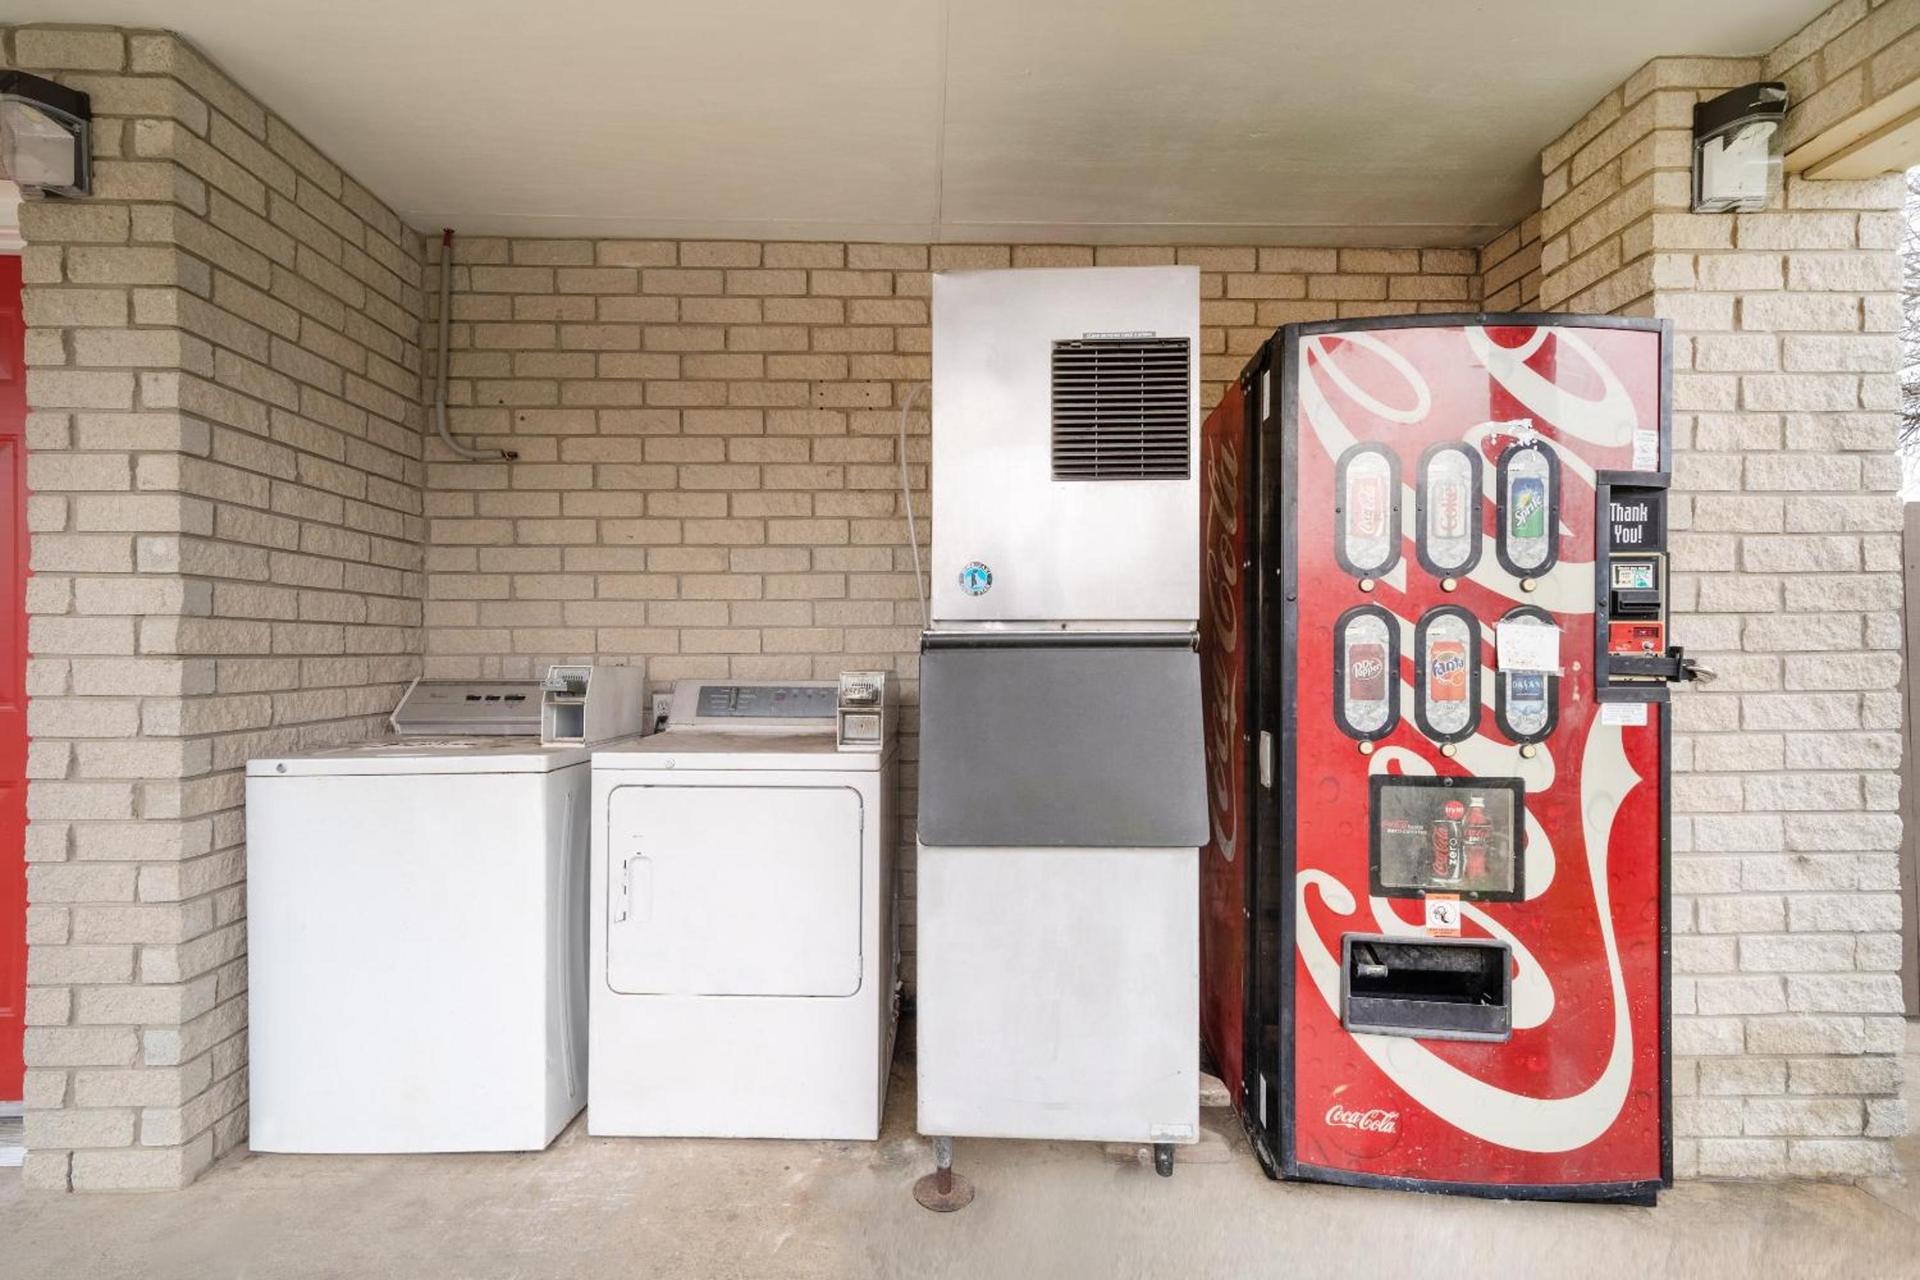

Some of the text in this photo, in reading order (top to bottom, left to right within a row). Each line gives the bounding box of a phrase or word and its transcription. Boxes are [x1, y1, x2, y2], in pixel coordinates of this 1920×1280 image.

[1514, 494, 1543, 527] Sprite
[1610, 503, 1648, 522] Thank
[1614, 525, 1642, 543] You!
[1432, 656, 1464, 677] Fanta
[1449, 837, 1458, 865] zero
[1325, 1104, 1400, 1134] Coca-Cola
